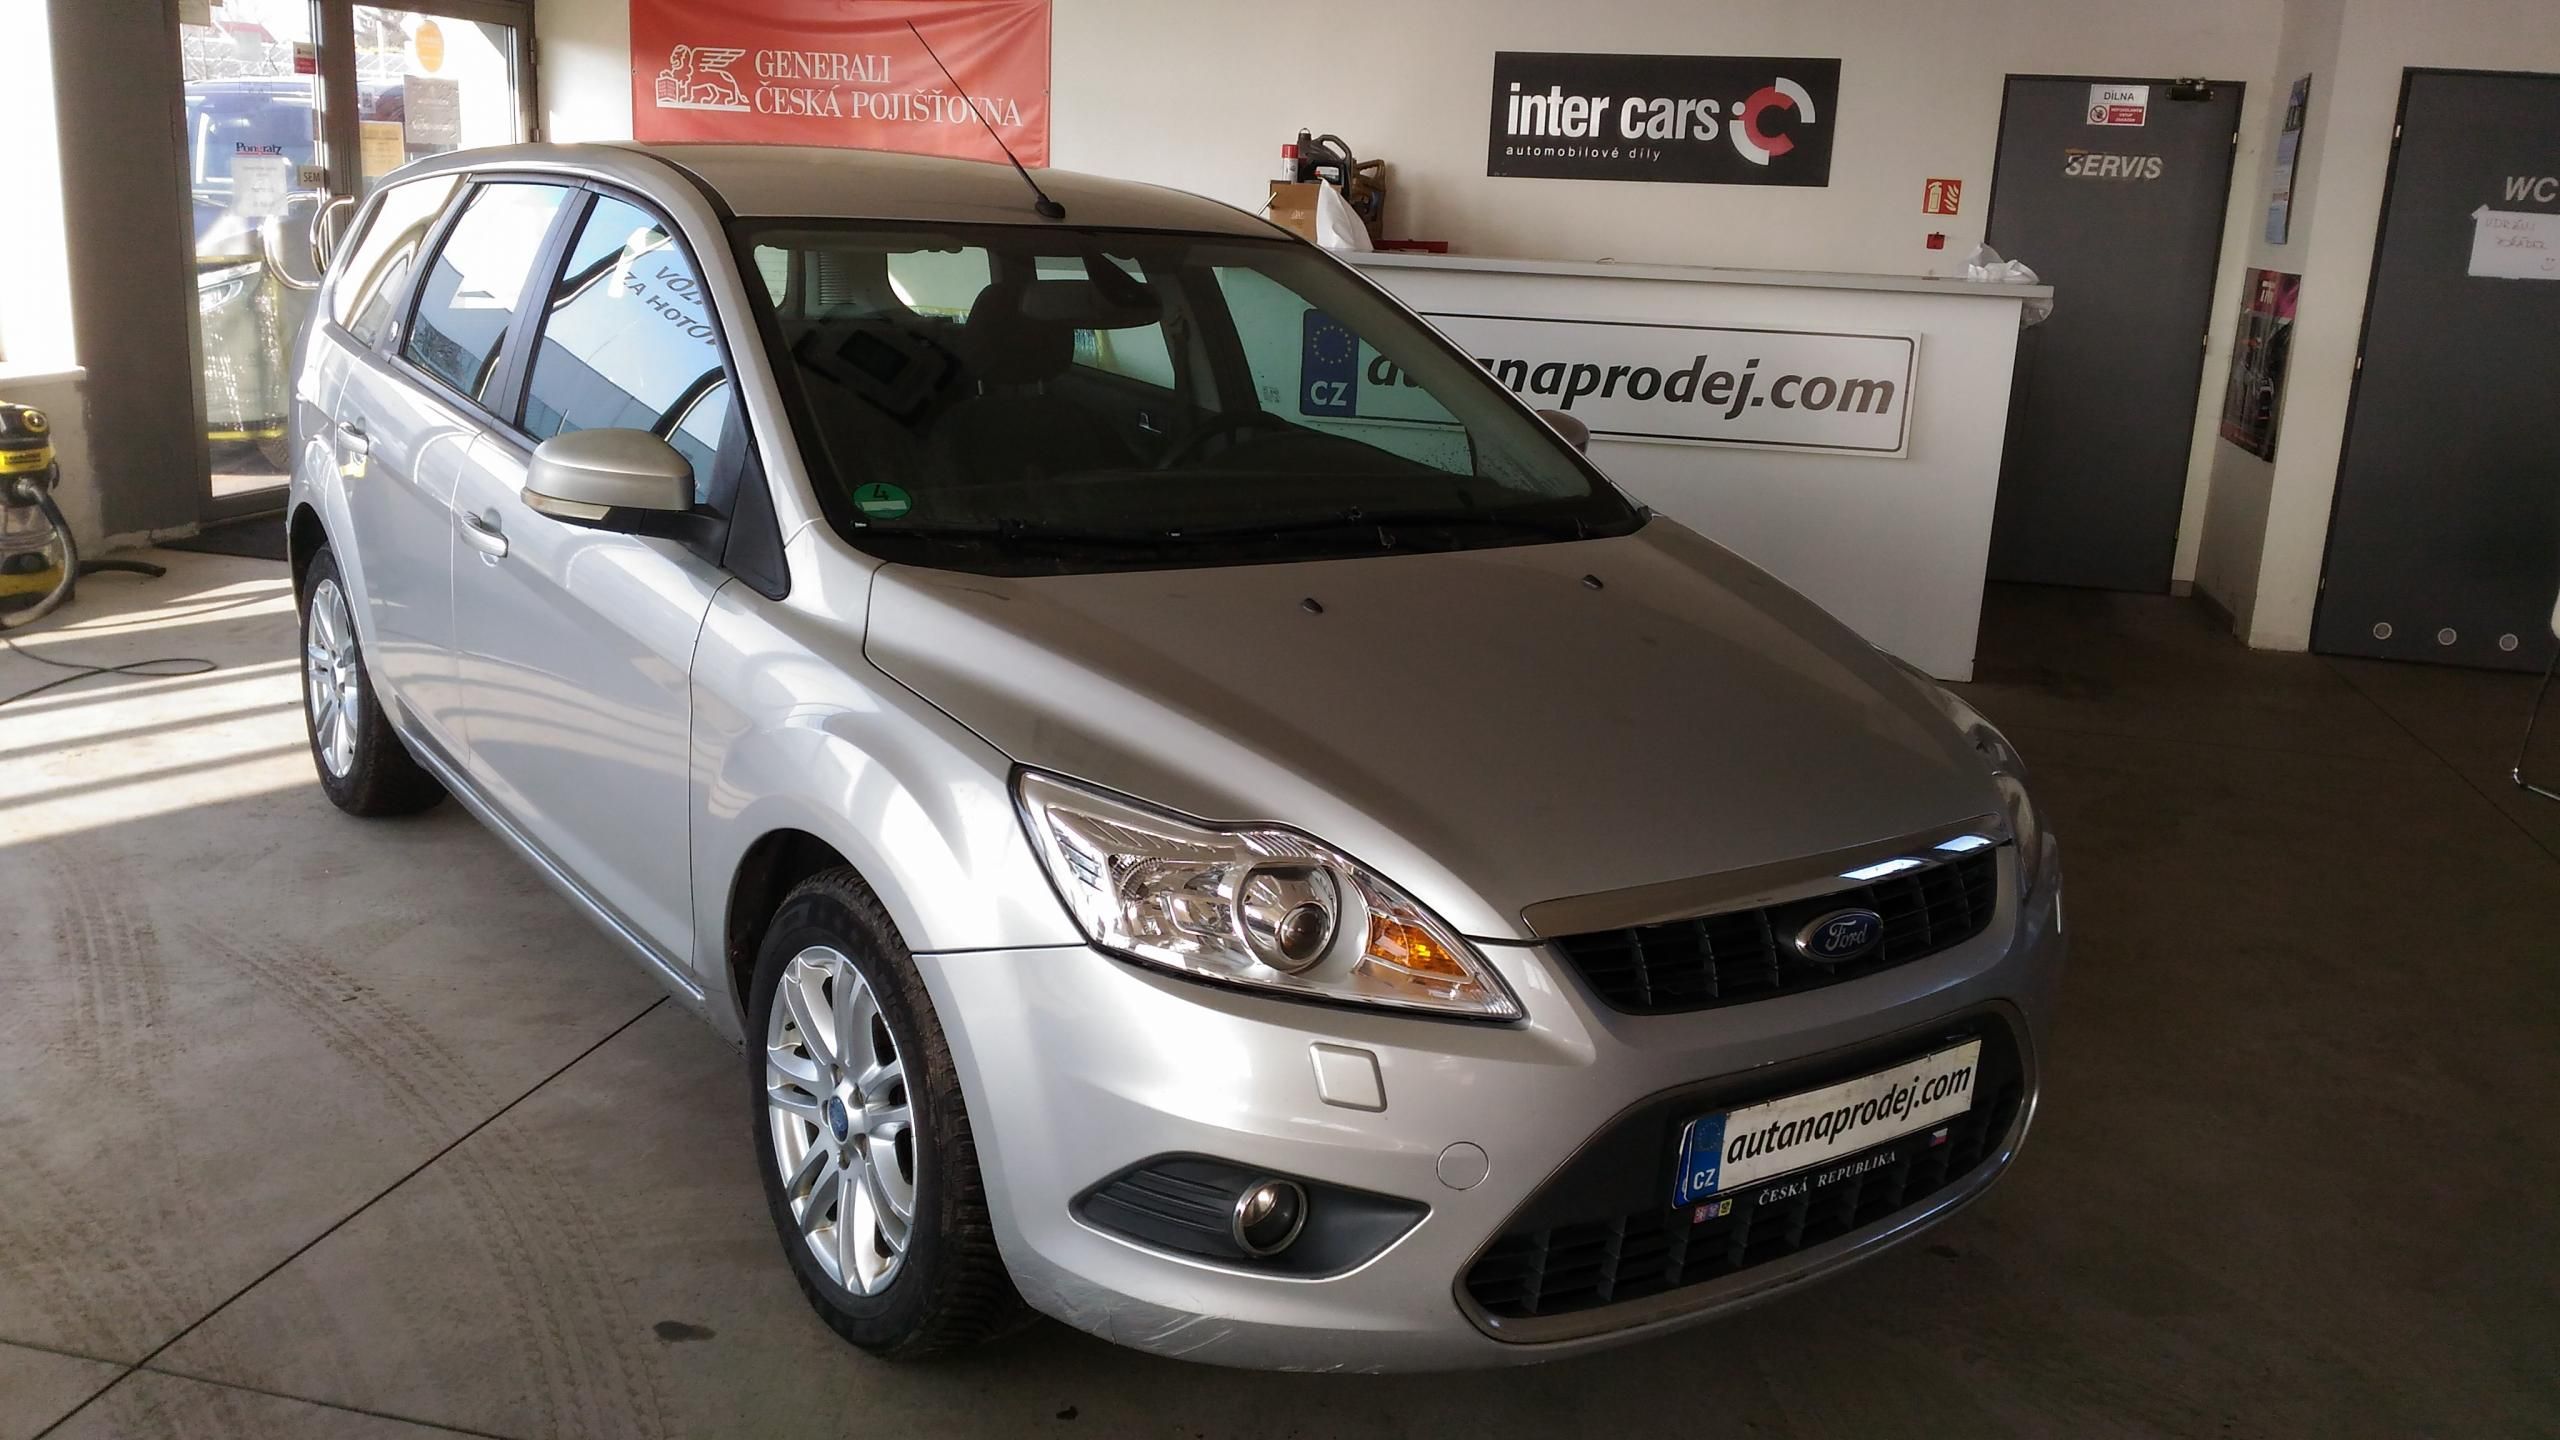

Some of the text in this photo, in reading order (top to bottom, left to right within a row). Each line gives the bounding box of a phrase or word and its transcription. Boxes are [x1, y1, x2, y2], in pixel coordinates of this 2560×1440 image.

[754, 49, 892, 84] GENERALI
[754, 81, 1024, 128] ČESKÁ POJIŠŤOVNA
[2103, 90, 2135, 101] DÍLNA
[1506, 82, 1721, 142] inter cars
[1505, 145, 1662, 162] automobilové díly
[2064, 154, 2164, 179] SERVIS
[303, 171, 321, 183] SEM
[2505, 176, 2560, 203] WC
[1310, 380, 1349, 407] CZ
[872, 485, 889, 501] 4
[1825, 919, 1869, 952] Ford
[1726, 1065, 1972, 1166] autanaprodej.com
[1692, 1167, 1717, 1191] CZ
[1757, 1151, 1897, 1207] ČESKÁ REPUBLIKA
